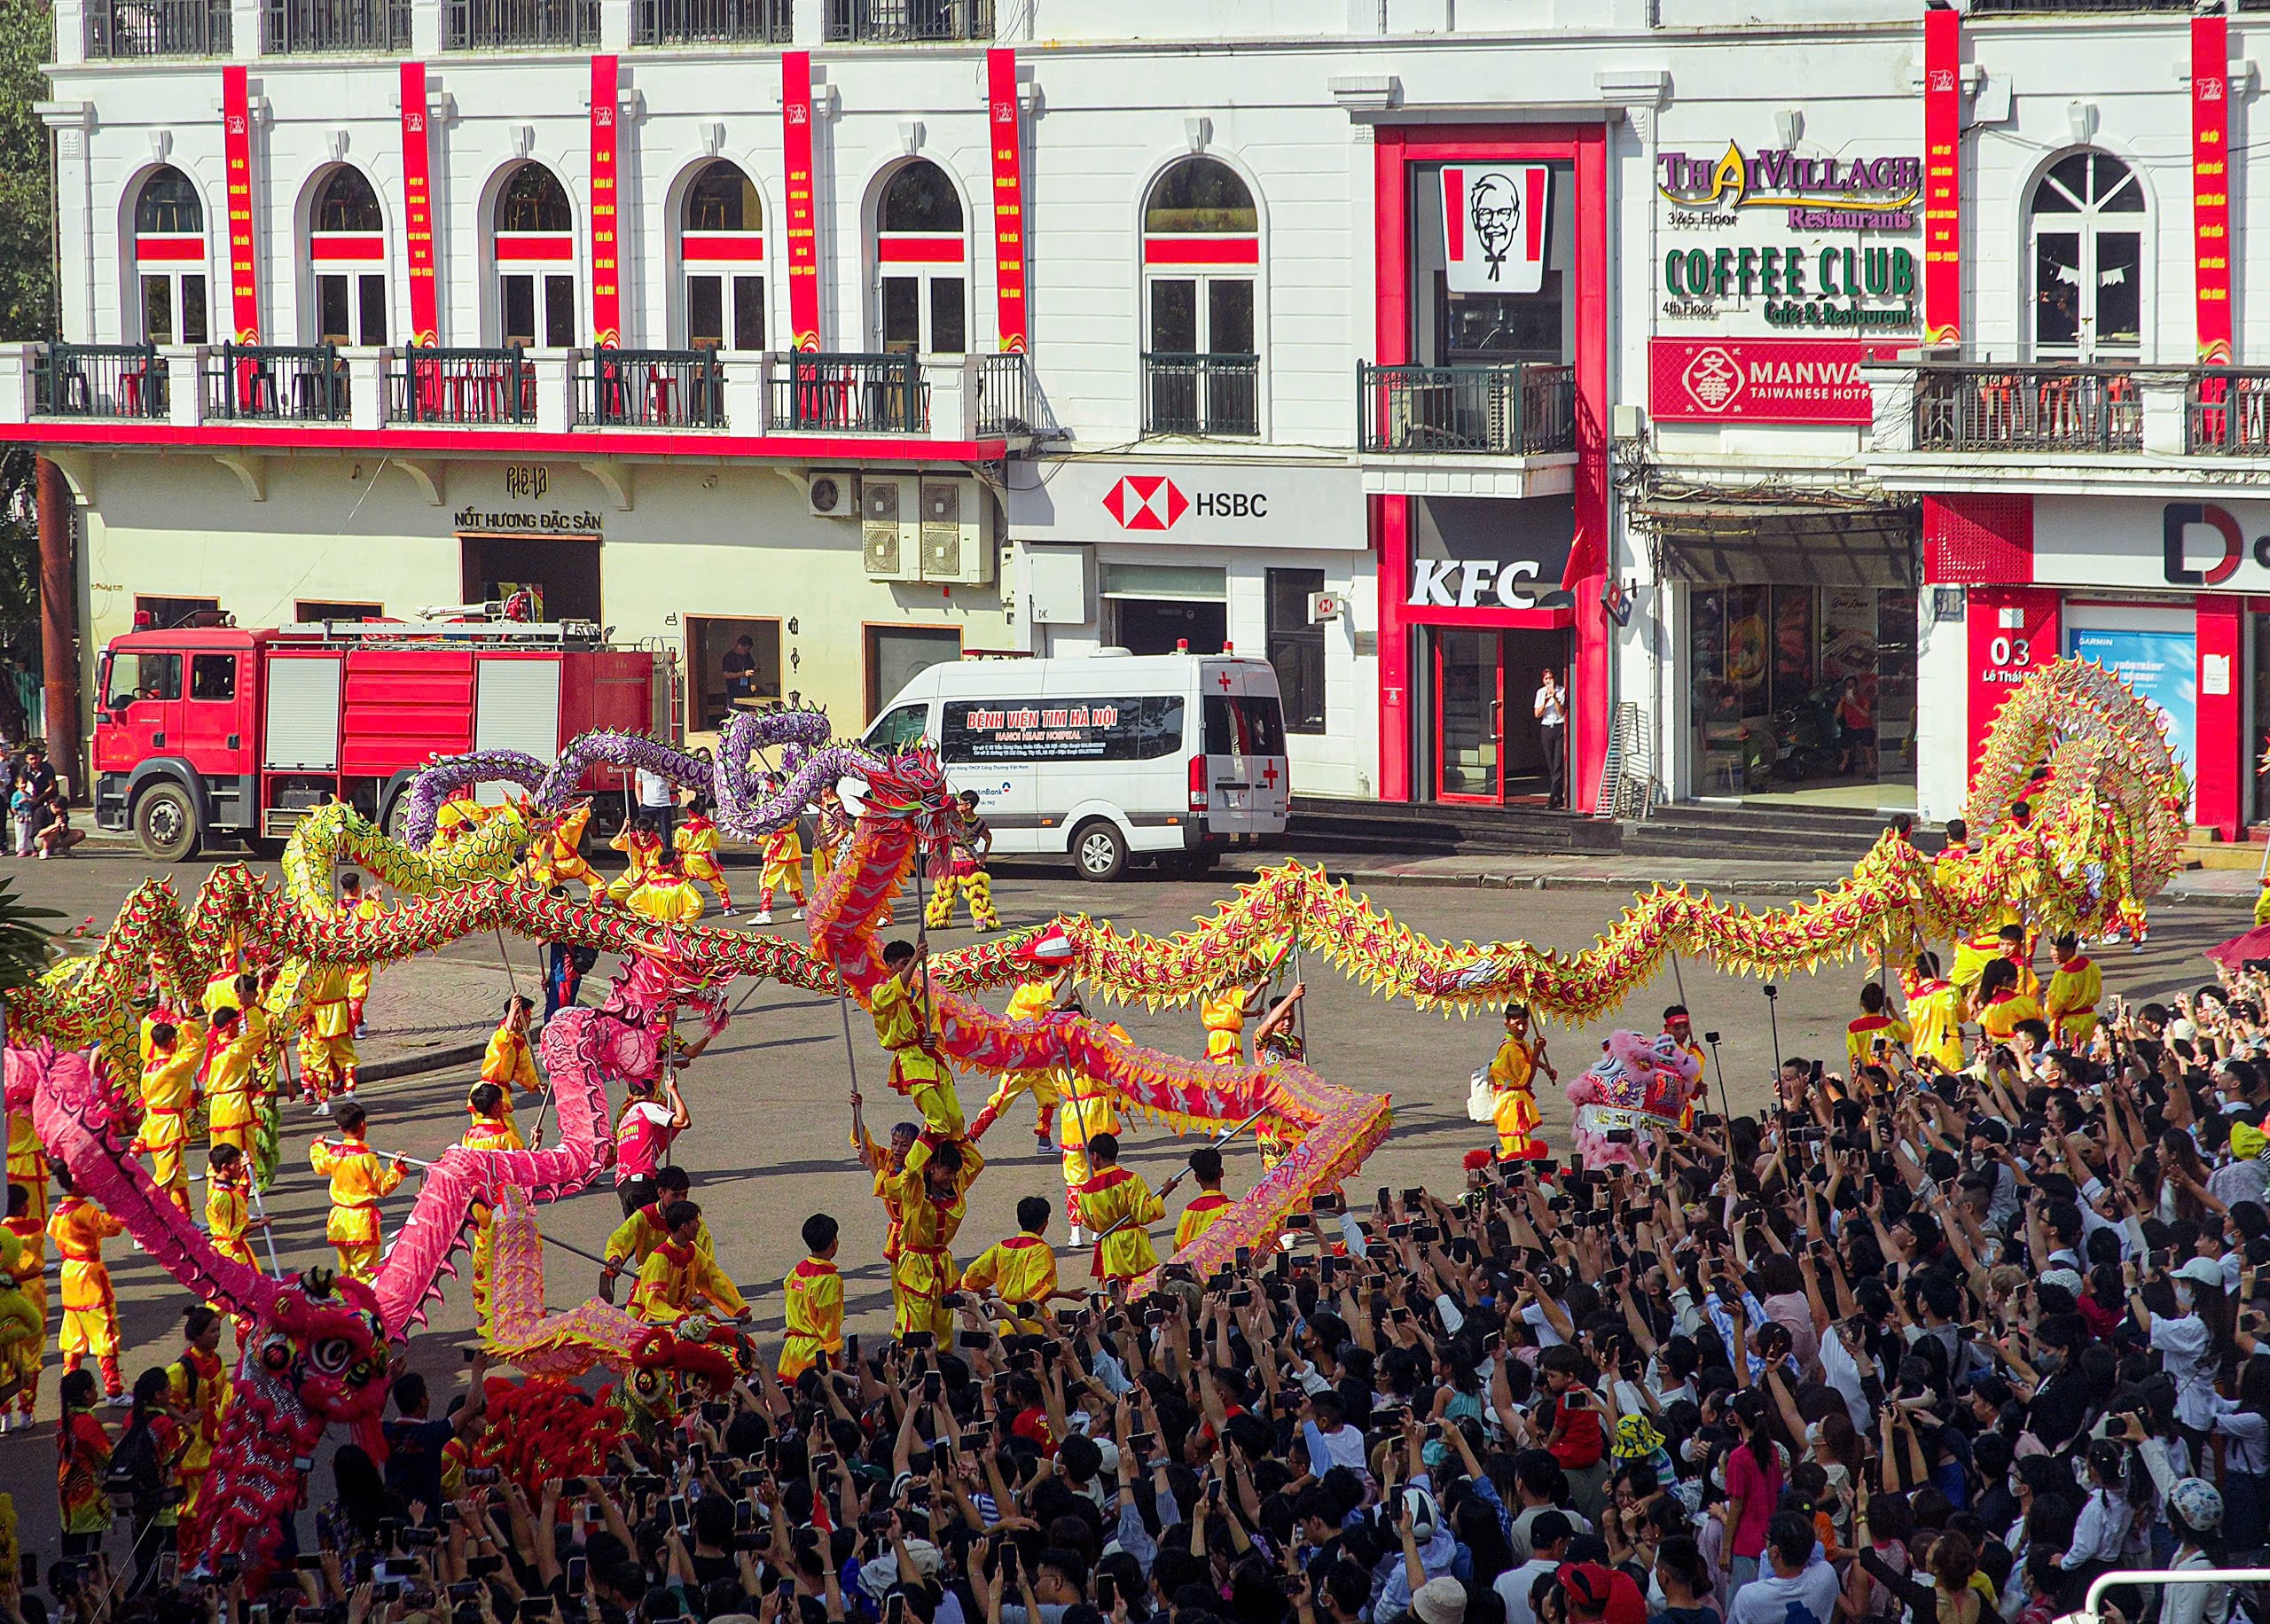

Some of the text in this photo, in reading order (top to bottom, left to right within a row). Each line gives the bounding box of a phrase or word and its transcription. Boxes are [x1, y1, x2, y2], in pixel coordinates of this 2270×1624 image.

[1702, 212, 1738, 225] Floor
[1787, 207, 1914, 229] Restaurants
[1666, 246, 1914, 295] COFFEE CLUB
[1663, 301, 1713, 314] 4th Floor
[1764, 300, 1914, 325] Café & Restaurant
[1693, 355, 1734, 405] 文華
[1750, 362, 1865, 384] MANWA
[1750, 387, 1872, 400] TAIWANESE HOTP
[454, 506, 482, 526] NỐT
[485, 511, 536, 527] HƯƠNG
[573, 511, 601, 529] SẢN
[1196, 493, 1268, 519] HSBC
[1408, 558, 1540, 608] KFC
[1937, 590, 1962, 613] 3B
[1990, 636, 2031, 666] 03
[1983, 670, 1997, 682] Lê
[1999, 670, 2022, 683] Thái
[967, 705, 1118, 732] BỆNH VIỆN TIM HÀ NỘI
[996, 730, 1081, 741] HANOI HEART HOSPITAL
